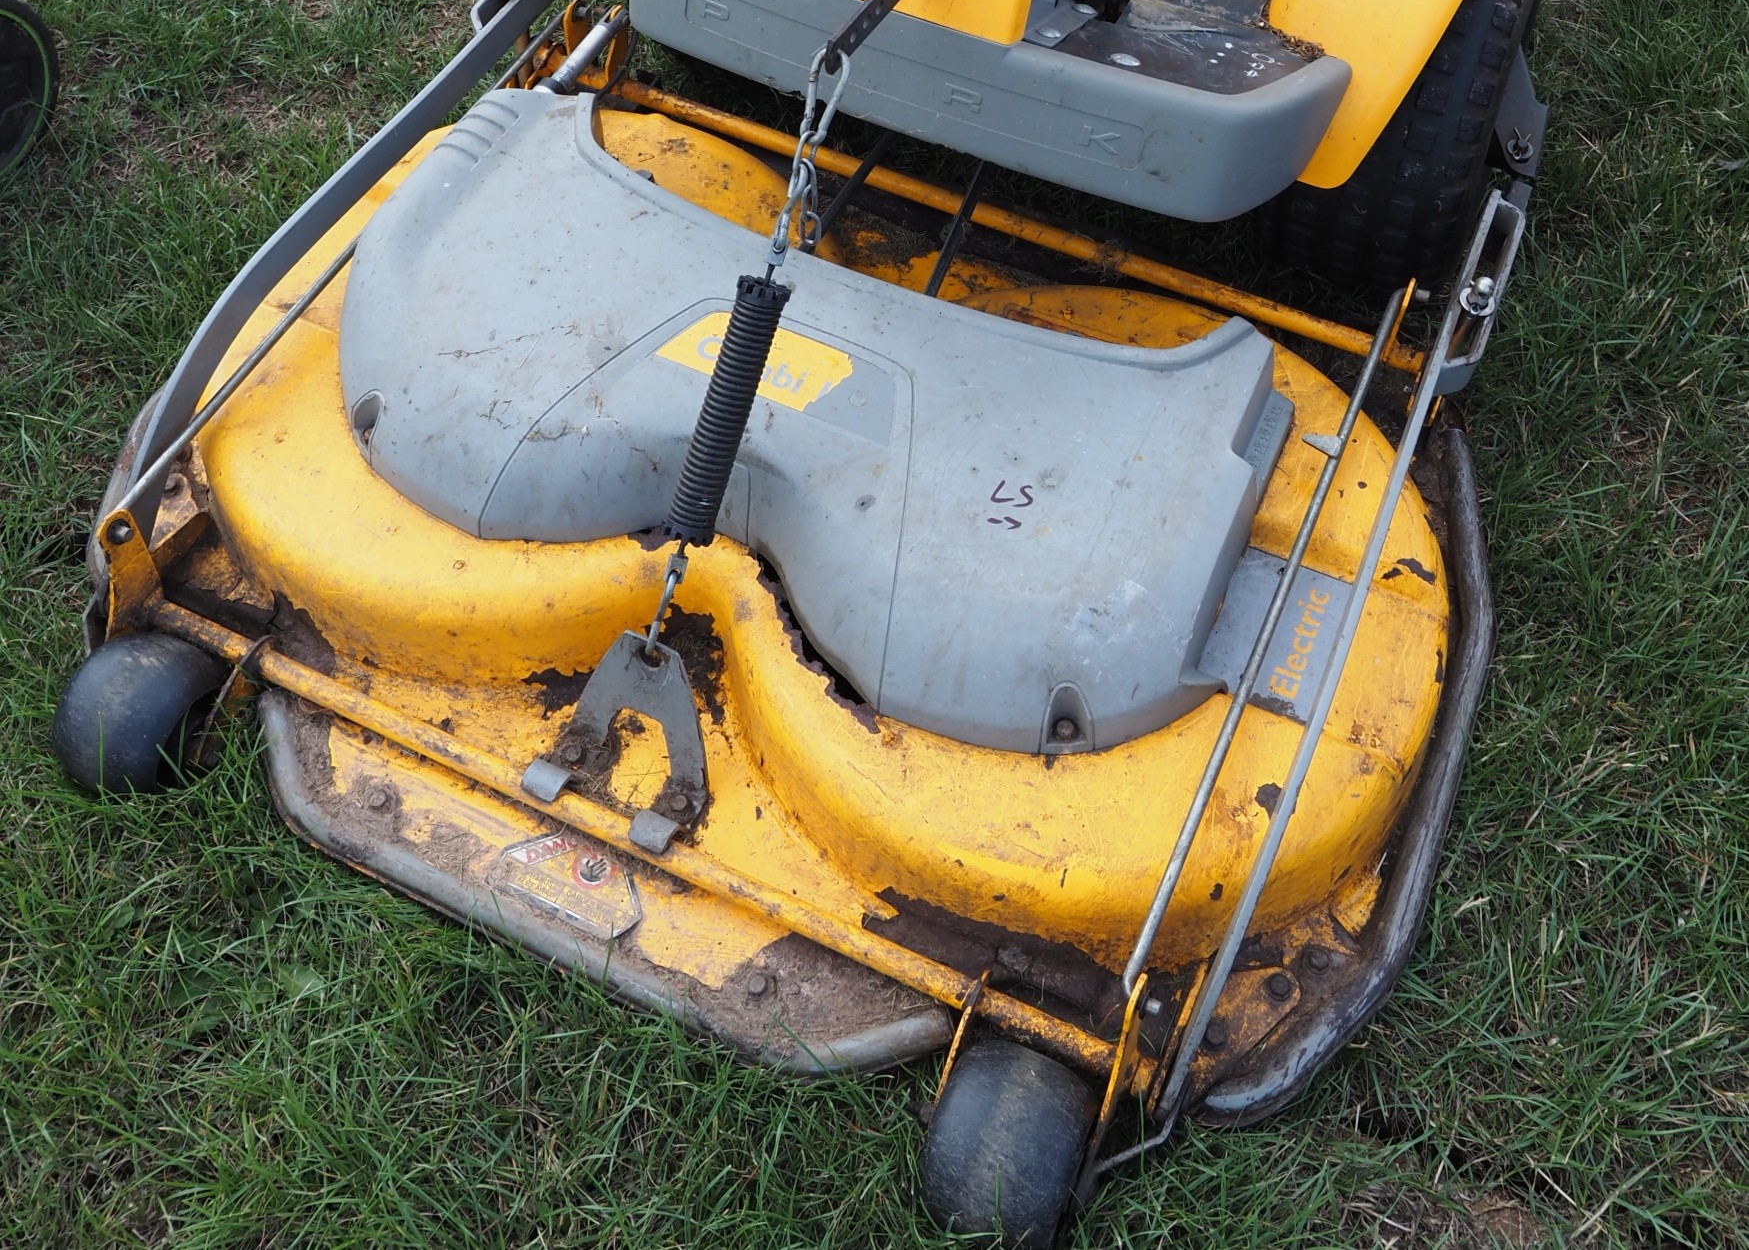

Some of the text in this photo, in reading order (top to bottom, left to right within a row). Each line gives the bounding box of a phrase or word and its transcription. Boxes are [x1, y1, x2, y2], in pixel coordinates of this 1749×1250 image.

[697, 336, 808, 394] Cbi
[990, 479, 1034, 508] LS
[1268, 588, 1331, 700] Electric
